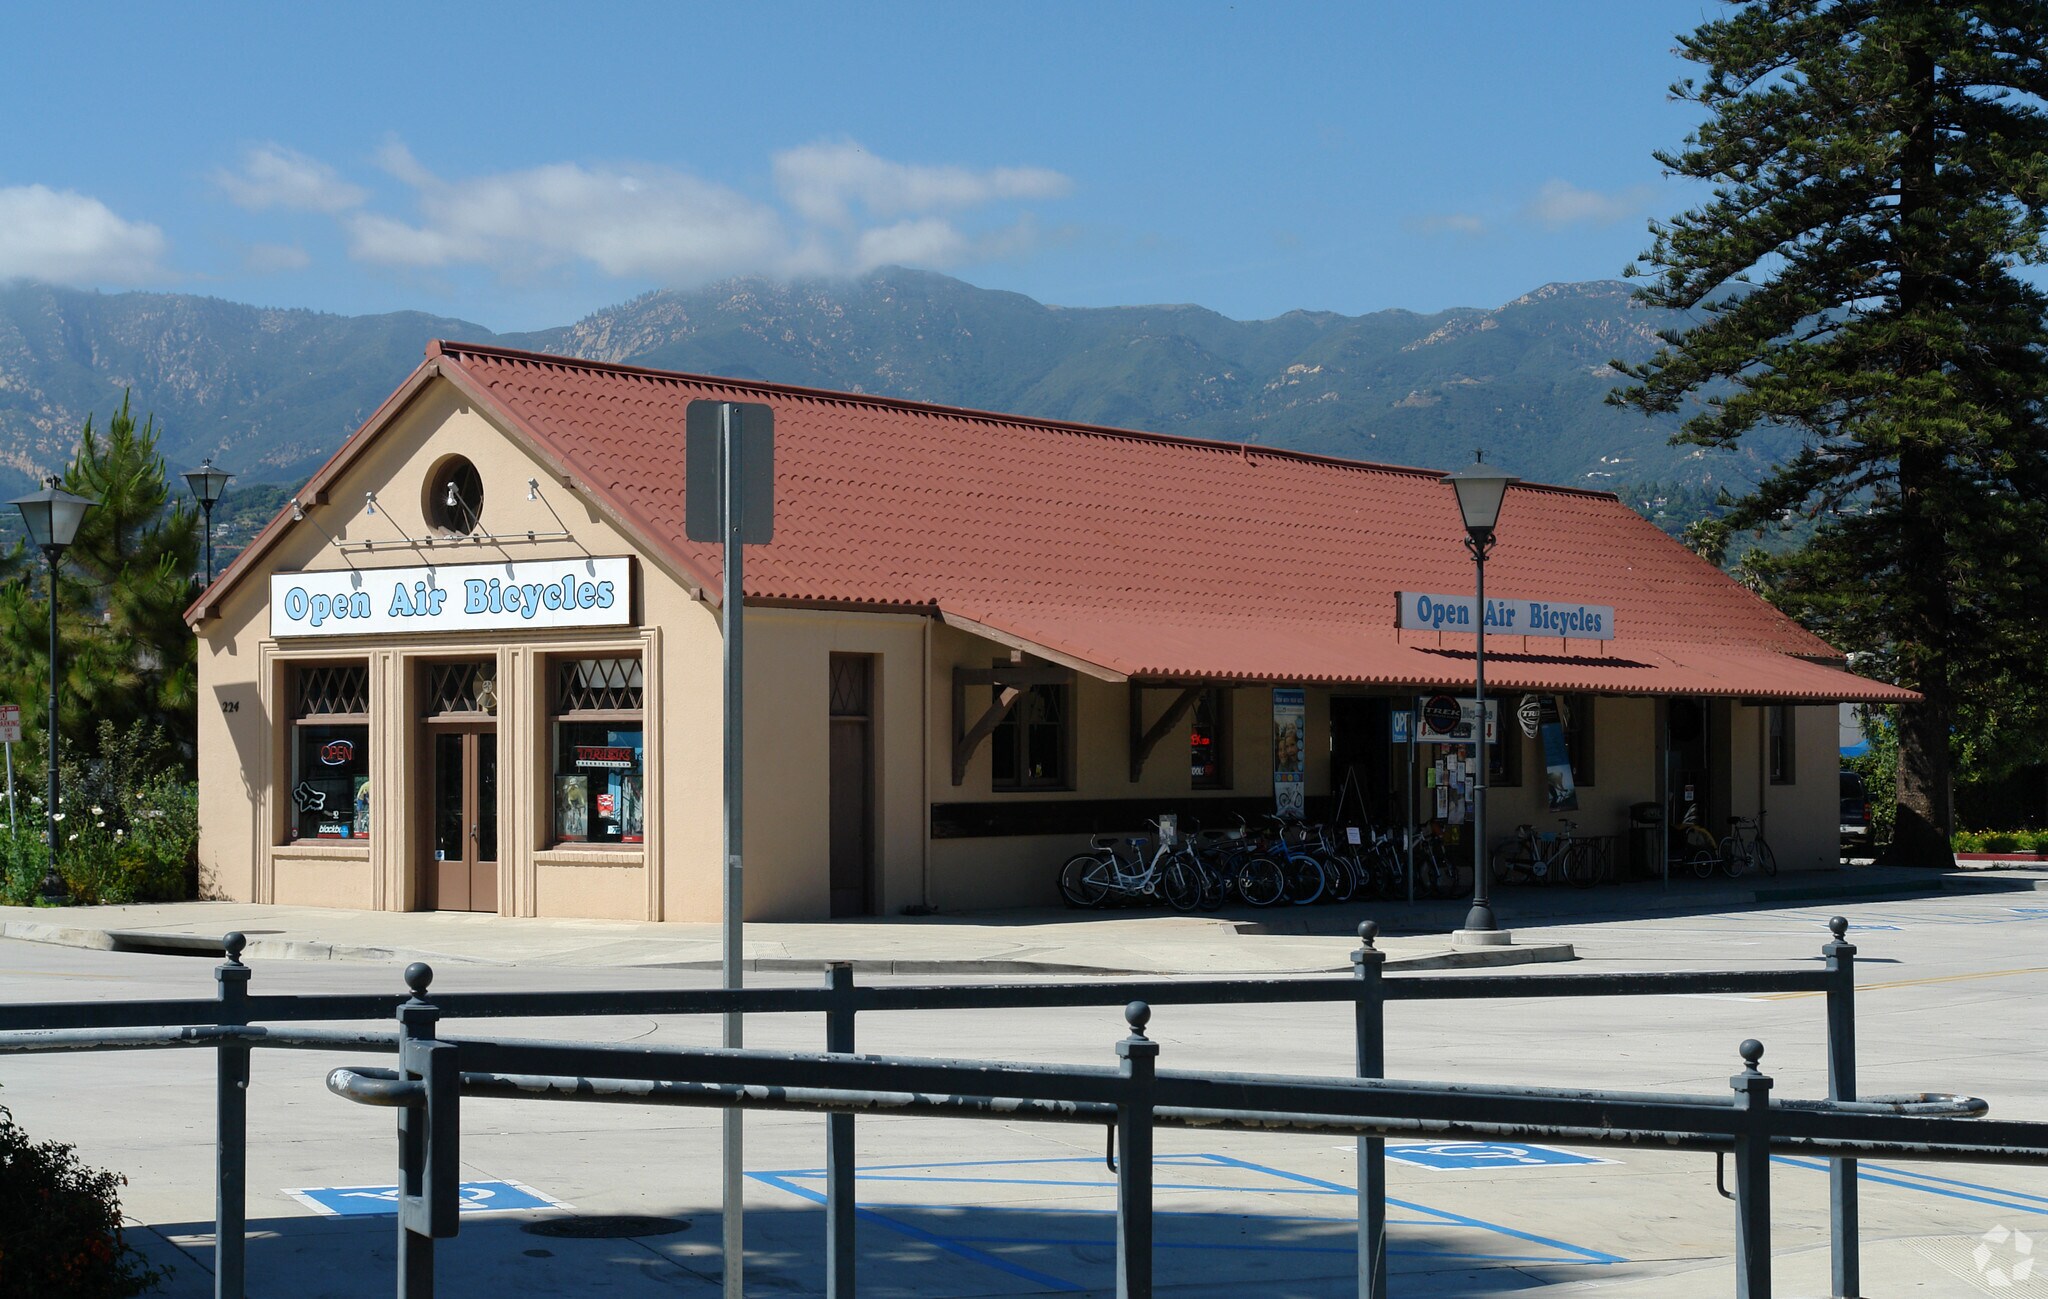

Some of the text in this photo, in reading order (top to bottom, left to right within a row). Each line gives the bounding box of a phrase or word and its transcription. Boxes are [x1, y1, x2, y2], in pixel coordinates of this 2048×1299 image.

[285, 574, 615, 627] Open Air Bicycles
[1417, 595, 1602, 636] Open Air Bicycles
[222, 701, 240, 713] 224
[1425, 707, 1461, 716] TREK
[321, 745, 353, 761] OPEN
[577, 748, 631, 760] TREK
[319, 824, 342, 834] blackb
